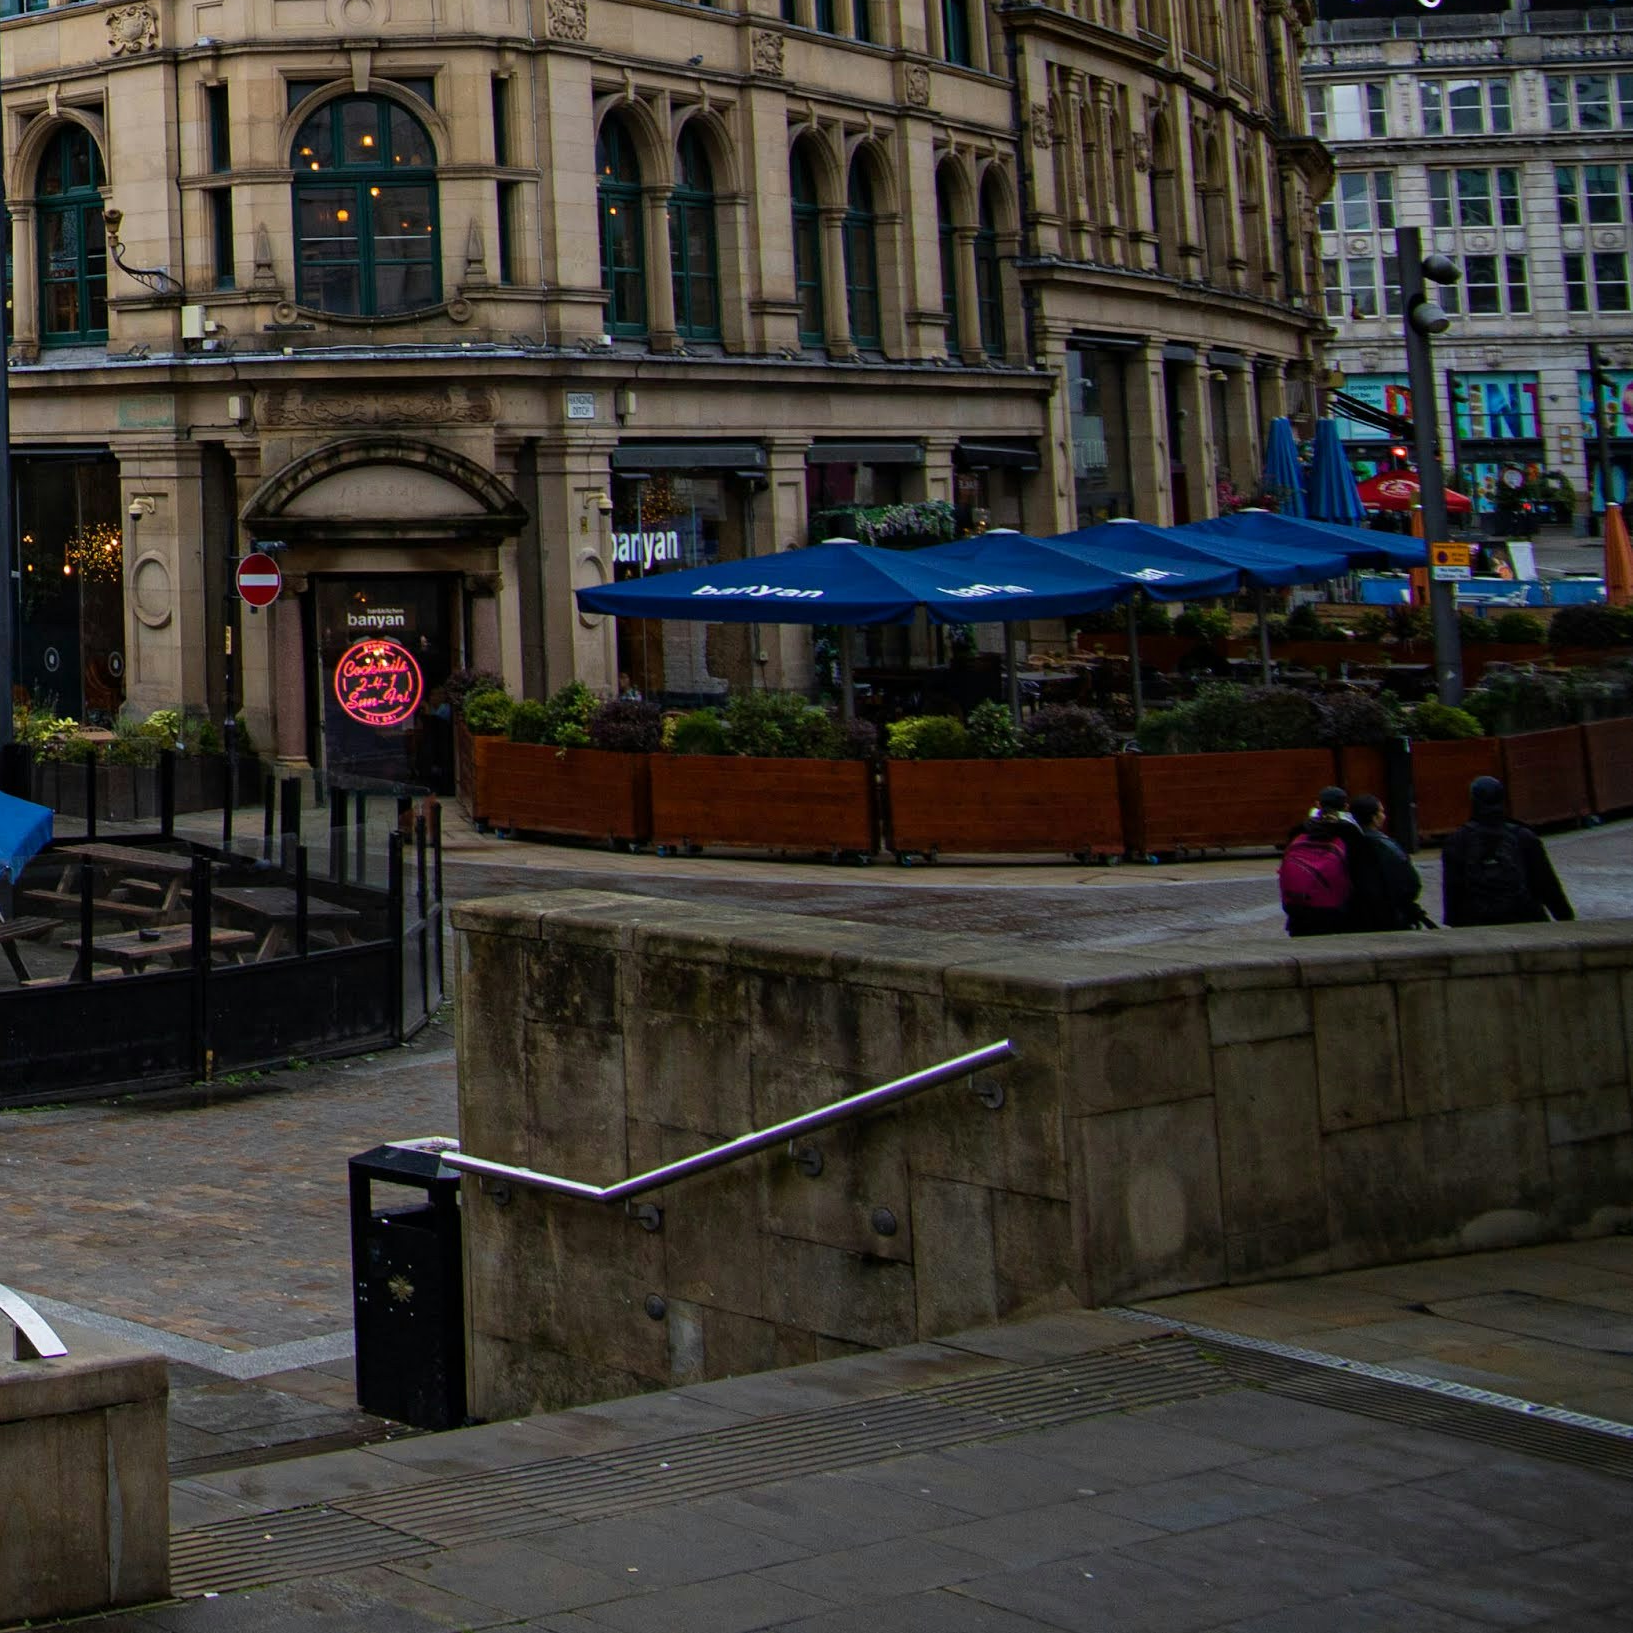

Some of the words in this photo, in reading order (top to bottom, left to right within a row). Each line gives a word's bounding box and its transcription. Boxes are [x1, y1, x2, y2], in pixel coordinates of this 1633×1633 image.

[692, 584, 826, 599] banyan
[347, 613, 405, 628] banyan
[343, 656, 409, 678] Cocktails
[354, 673, 397, 693] 2-4-1
